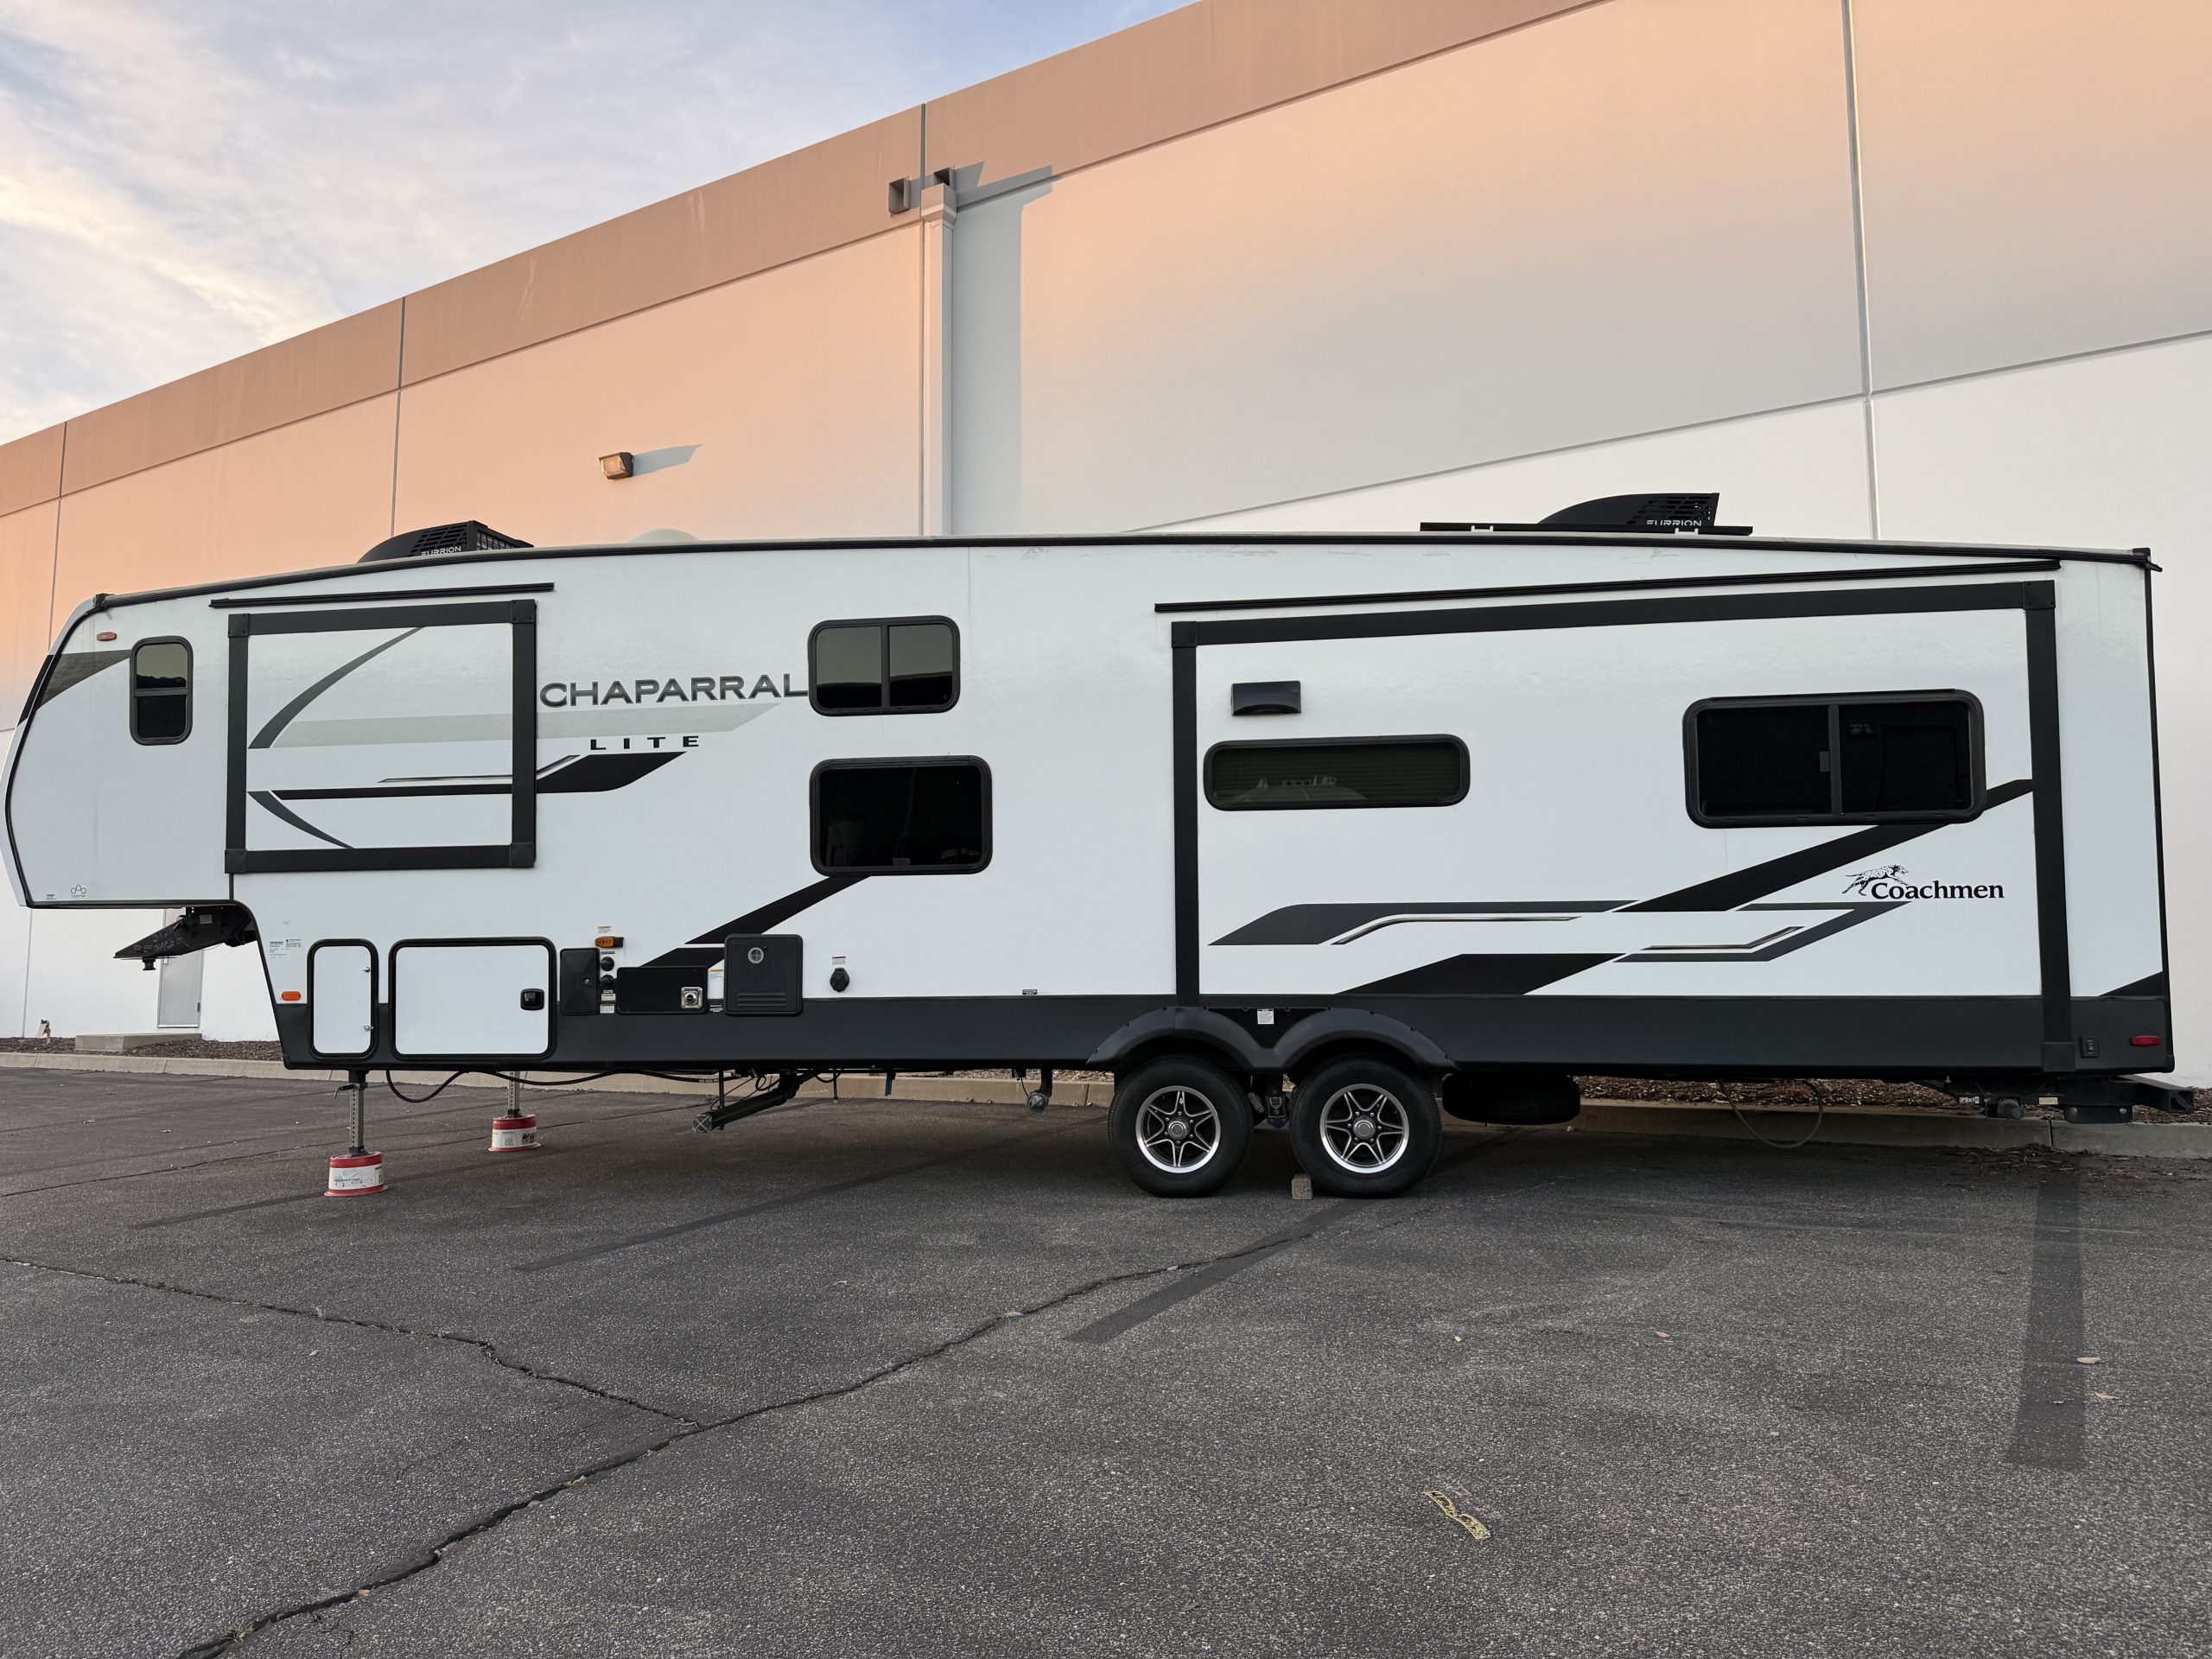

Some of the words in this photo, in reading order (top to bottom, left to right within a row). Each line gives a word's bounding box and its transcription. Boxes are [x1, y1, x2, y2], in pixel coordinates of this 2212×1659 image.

[539, 673, 809, 708] CHAPARRAL
[590, 735, 699, 751] LITE
[1871, 880, 2005, 899] Coachmen
